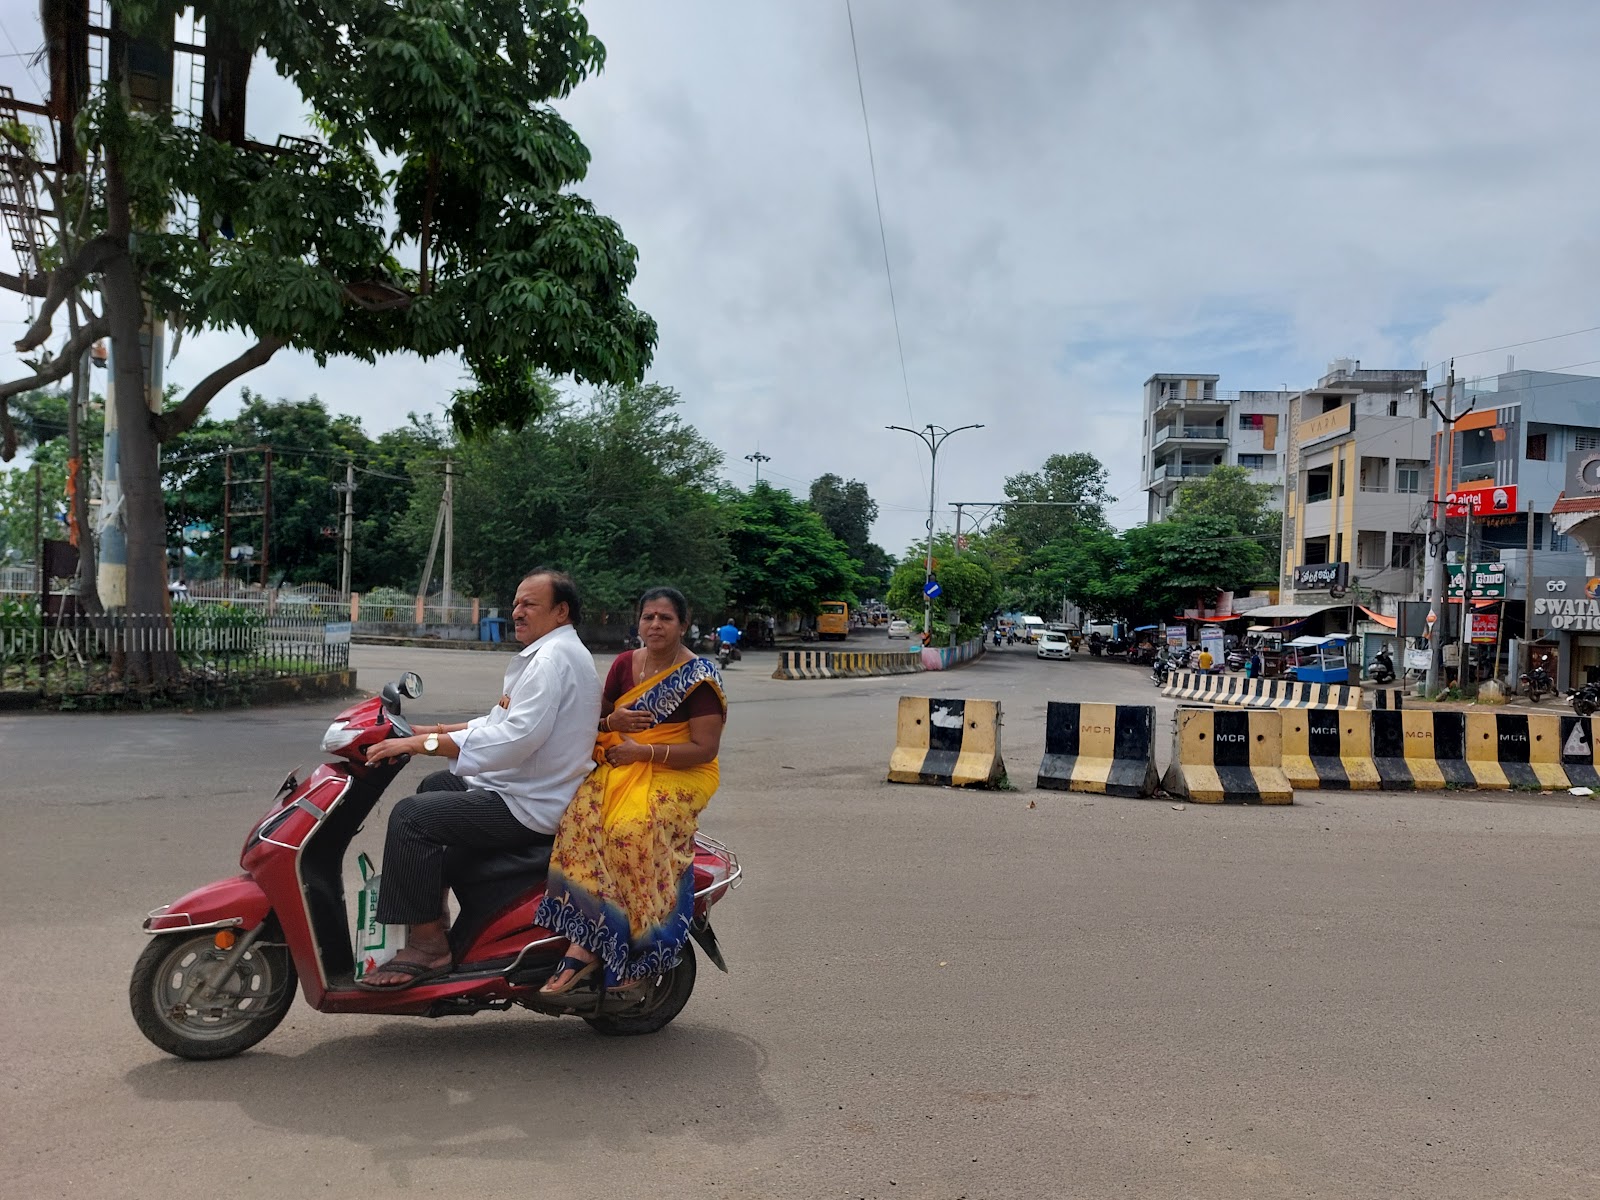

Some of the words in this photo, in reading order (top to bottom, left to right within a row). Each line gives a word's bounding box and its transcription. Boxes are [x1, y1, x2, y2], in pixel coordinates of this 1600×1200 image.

[1457, 493, 1482, 505] airtel
[1534, 598, 1600, 616] SWATA
[1081, 725, 1111, 734] MCR
[1311, 726, 1338, 735] MCR
[1216, 733, 1246, 743] MCR
[1405, 731, 1433, 739] MCR
[1500, 733, 1527, 742] MCR
[368, 916, 376, 936] UNI
